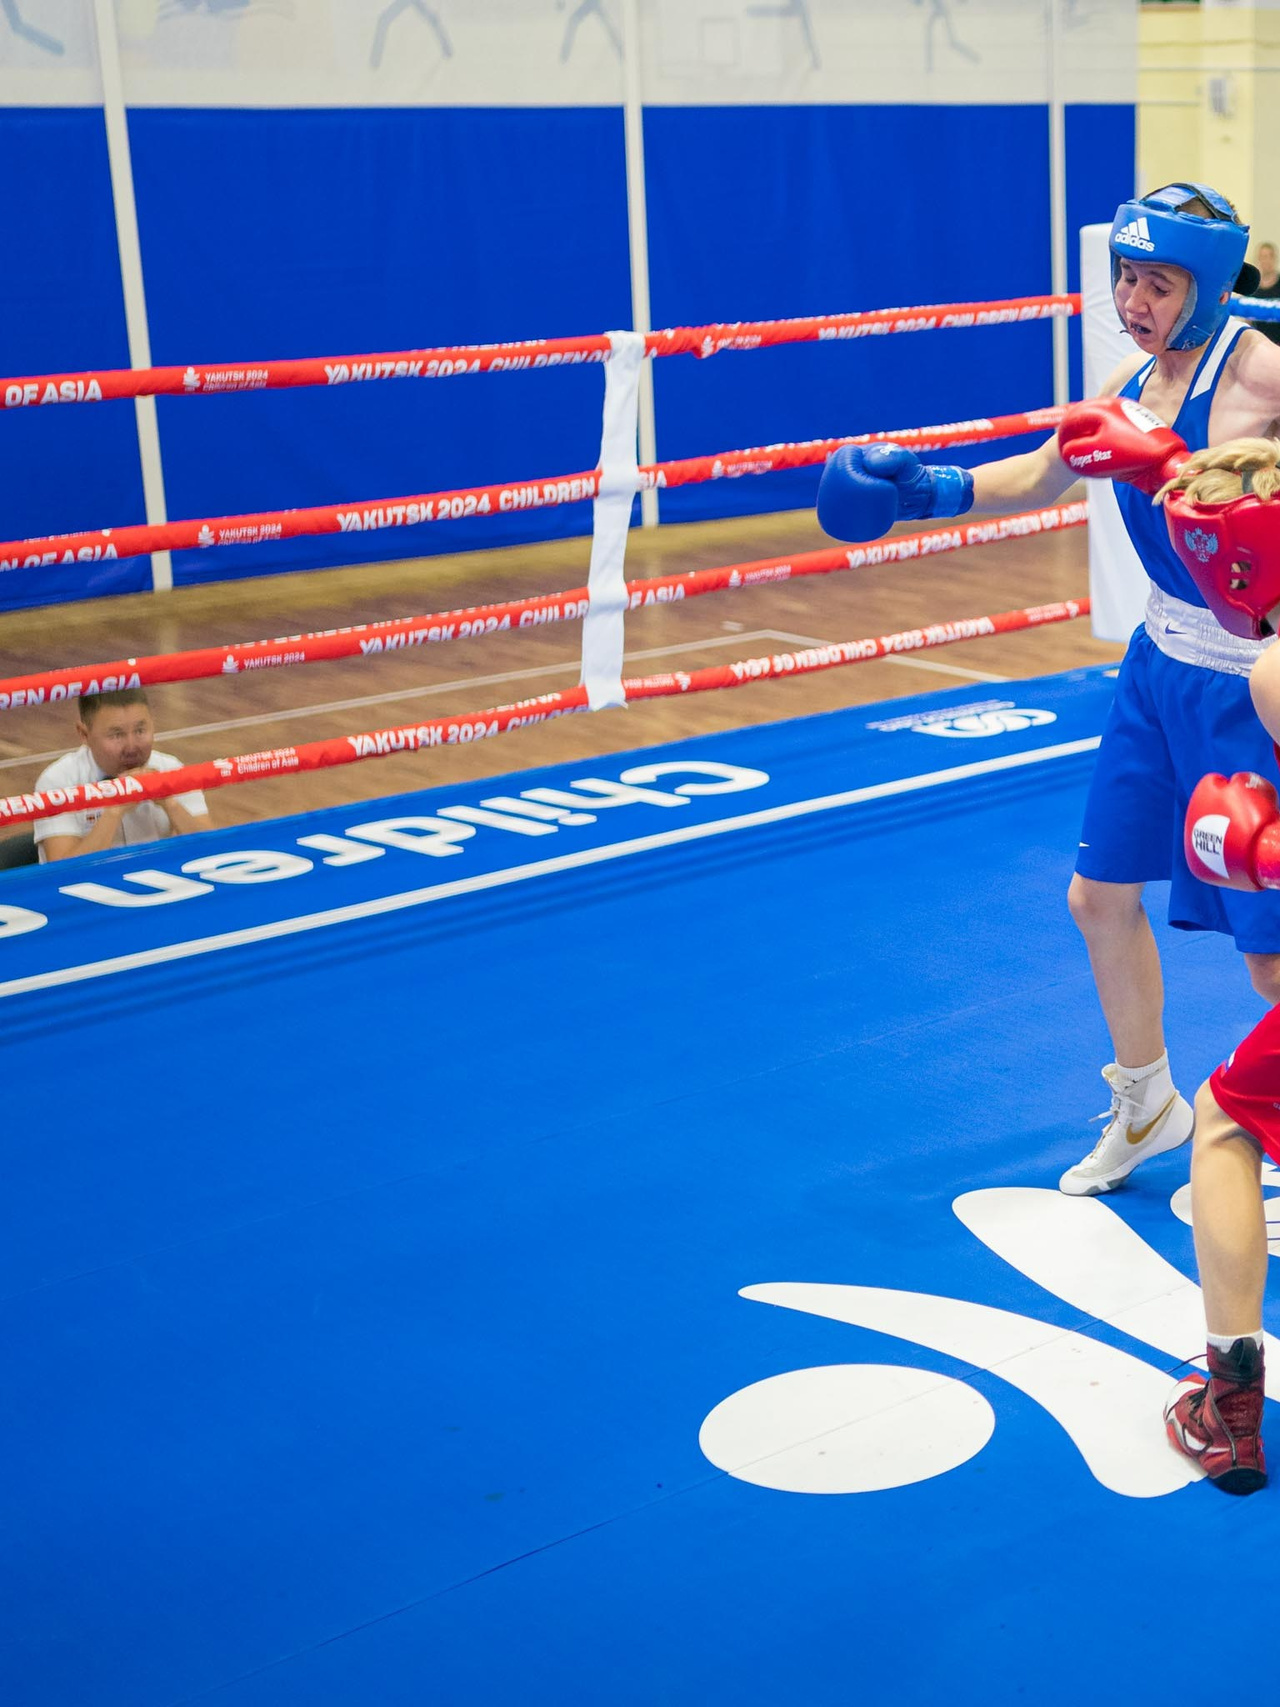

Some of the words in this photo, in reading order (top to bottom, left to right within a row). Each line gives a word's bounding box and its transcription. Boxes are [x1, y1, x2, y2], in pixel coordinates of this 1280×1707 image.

[1115, 232, 1155, 252] adidas
[324, 359, 423, 386] YAKUTSK
[425, 357, 481, 379] 2024
[5, 382, 39, 407] OF
[40, 379, 102, 404] ASIA
[337, 500, 434, 533] YAKUTSK
[437, 493, 491, 521] 2024
[499, 476, 595, 511] CHILDREN
[846, 538, 920, 570] YAKUTSK
[920, 530, 963, 554] 2024
[966, 513, 1042, 545] CHILDREN
[644, 583, 685, 607] ASIA
[360, 623, 456, 657] YAKUTSK
[459, 614, 511, 641] 2024
[519, 599, 589, 628] CHILDR
[881, 629, 924, 654] 2024
[924, 616, 995, 646] YAKUTSK
[50, 680, 83, 702] OF
[81, 672, 142, 697] ASIA
[347, 725, 443, 758] YAKUTSK
[447, 719, 499, 745] 2024
[237, 761, 270, 776] Children
[280, 755, 299, 769] Asia
[47, 785, 81, 808] OF
[84, 776, 143, 802] ASIA
[59, 760, 770, 908] Children
[1194, 828, 1223, 845] GREEN
[1195, 840, 1221, 855] HILL
